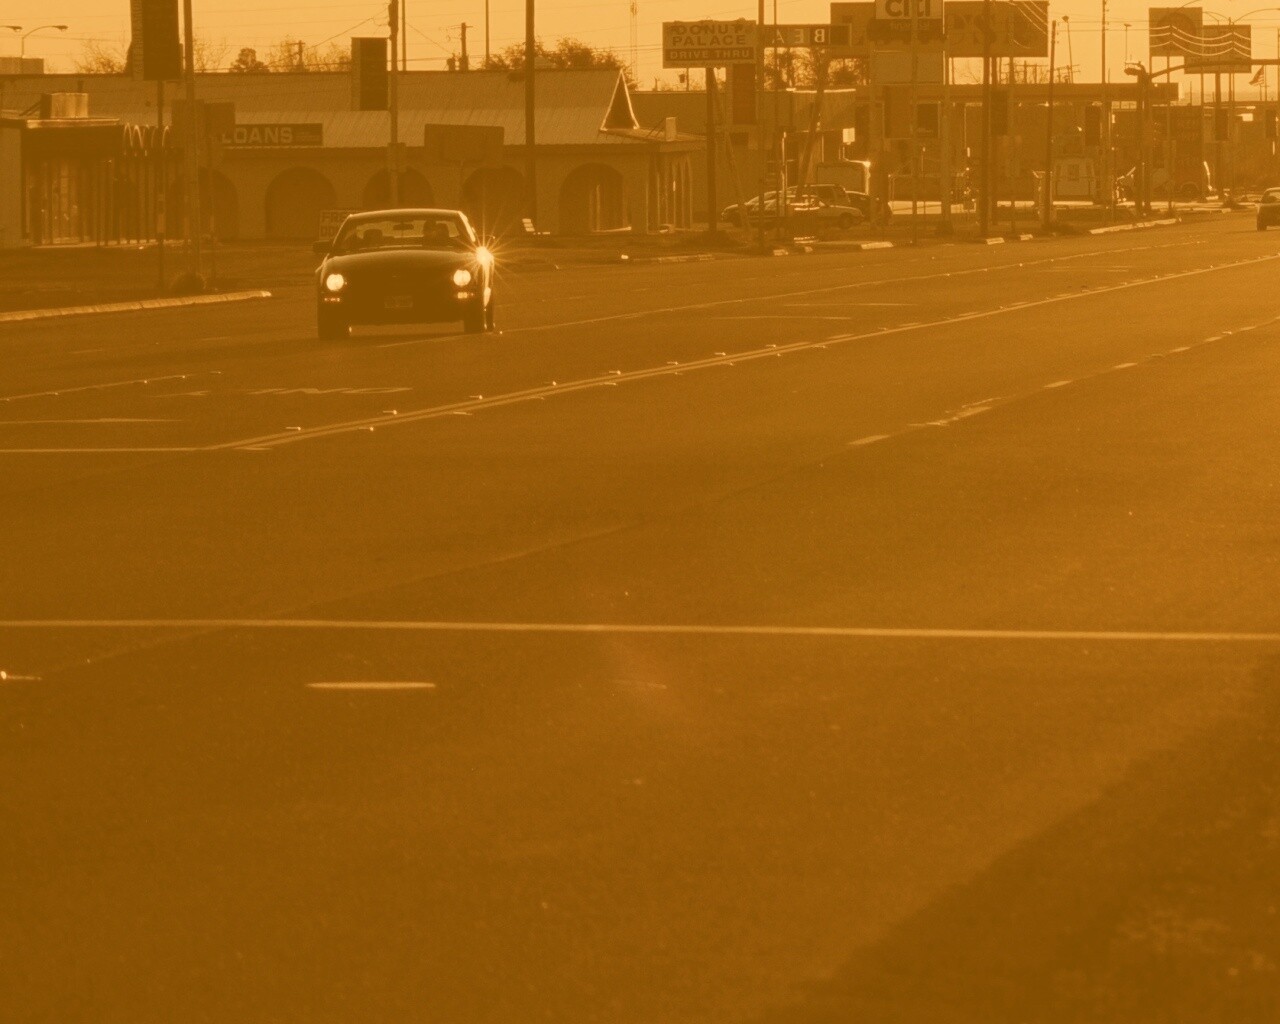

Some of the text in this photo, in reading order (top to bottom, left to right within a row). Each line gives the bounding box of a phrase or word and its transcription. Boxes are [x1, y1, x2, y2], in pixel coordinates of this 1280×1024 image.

[672, 23, 744, 36] DONUT
[672, 34, 747, 47] PALACE
[670, 48, 750, 60] DRIVE THRU
[222, 127, 293, 144] LOANS
